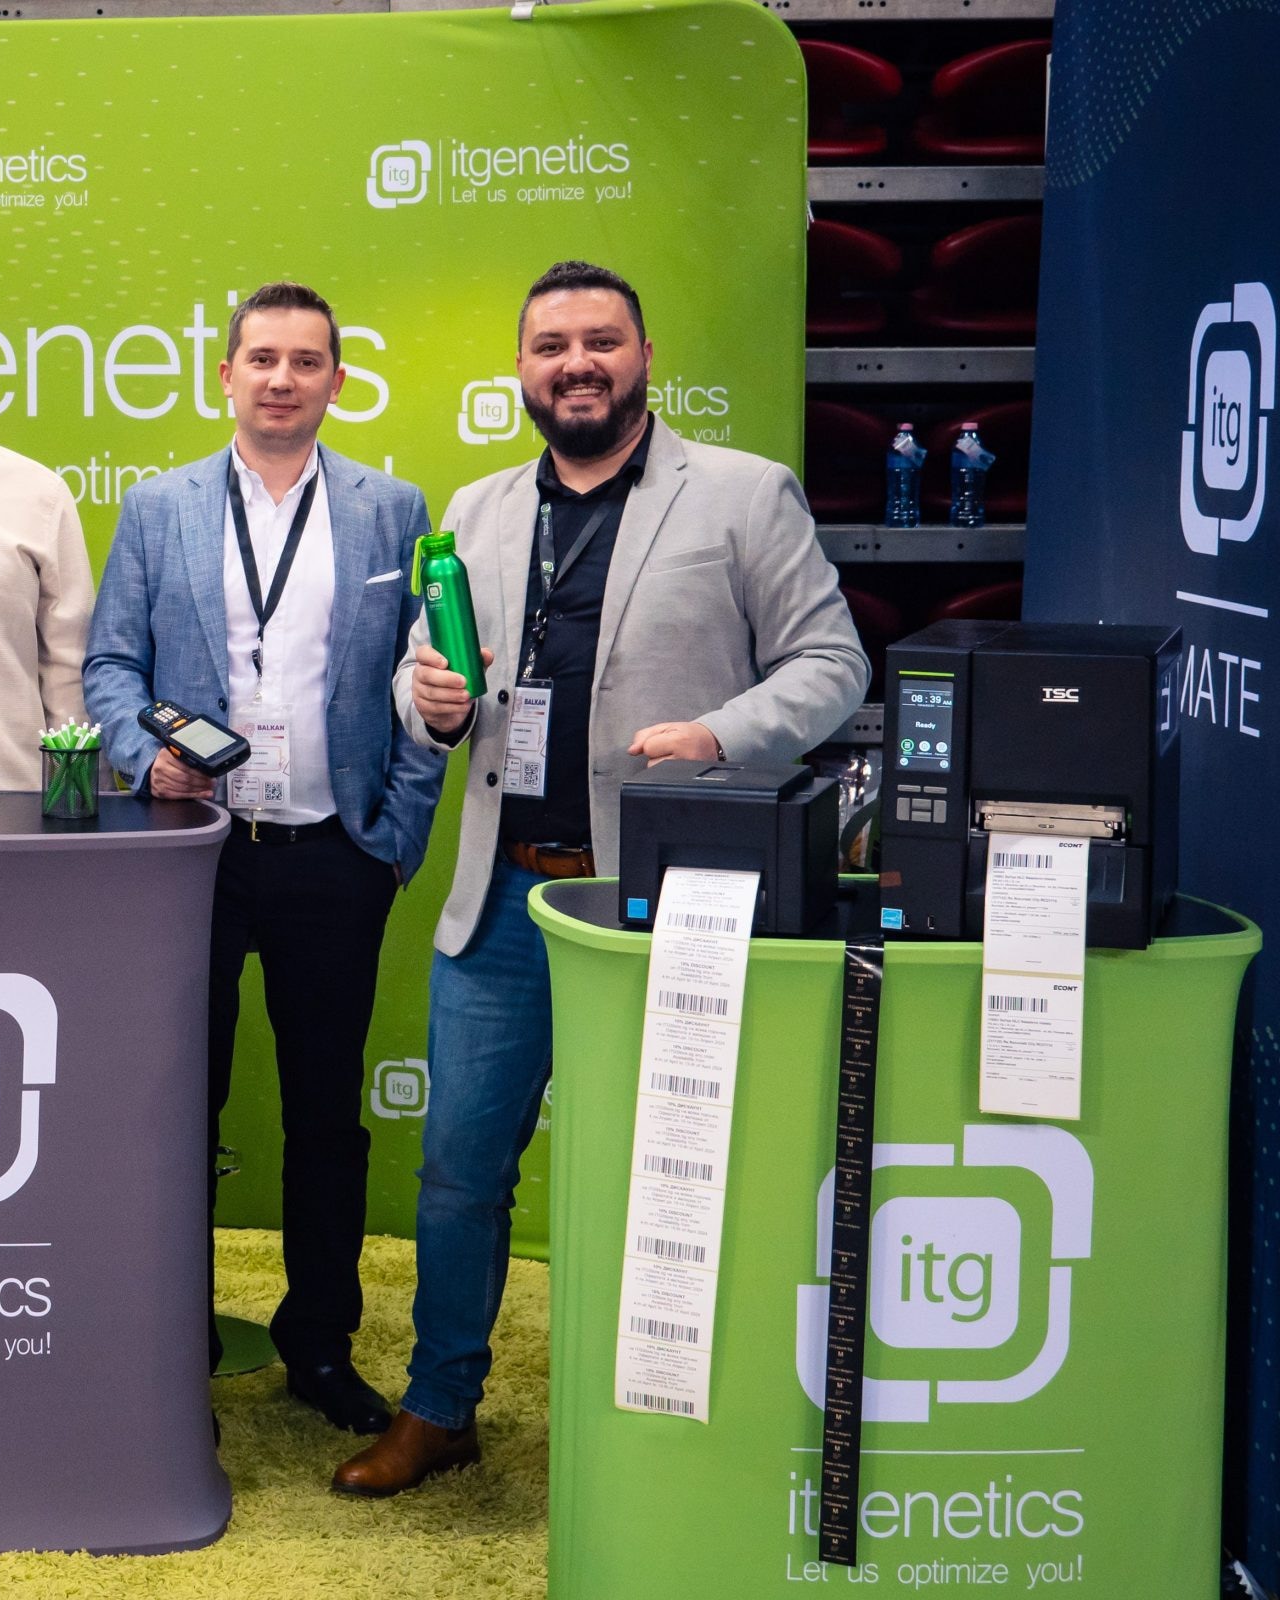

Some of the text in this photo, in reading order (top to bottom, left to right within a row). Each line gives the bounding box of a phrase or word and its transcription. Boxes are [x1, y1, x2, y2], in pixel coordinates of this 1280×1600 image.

[452, 134, 631, 187] itgenetics
[388, 166, 410, 186] itg
[55, 190, 89, 210] you!
[452, 182, 632, 205] Let us optimize you!
[480, 401, 502, 421] itg
[1211, 385, 1242, 467] itg
[524, 698, 546, 706] BALKAN
[1042, 687, 1079, 699] TSC
[915, 721, 936, 730] Ready
[392, 1080, 413, 1100] itg
[900, 1234, 993, 1323] itg
[4, 1331, 51, 1360] you!
[788, 1471, 1085, 1540] itenetics
[786, 1553, 1084, 1591] Let us optimize you!
